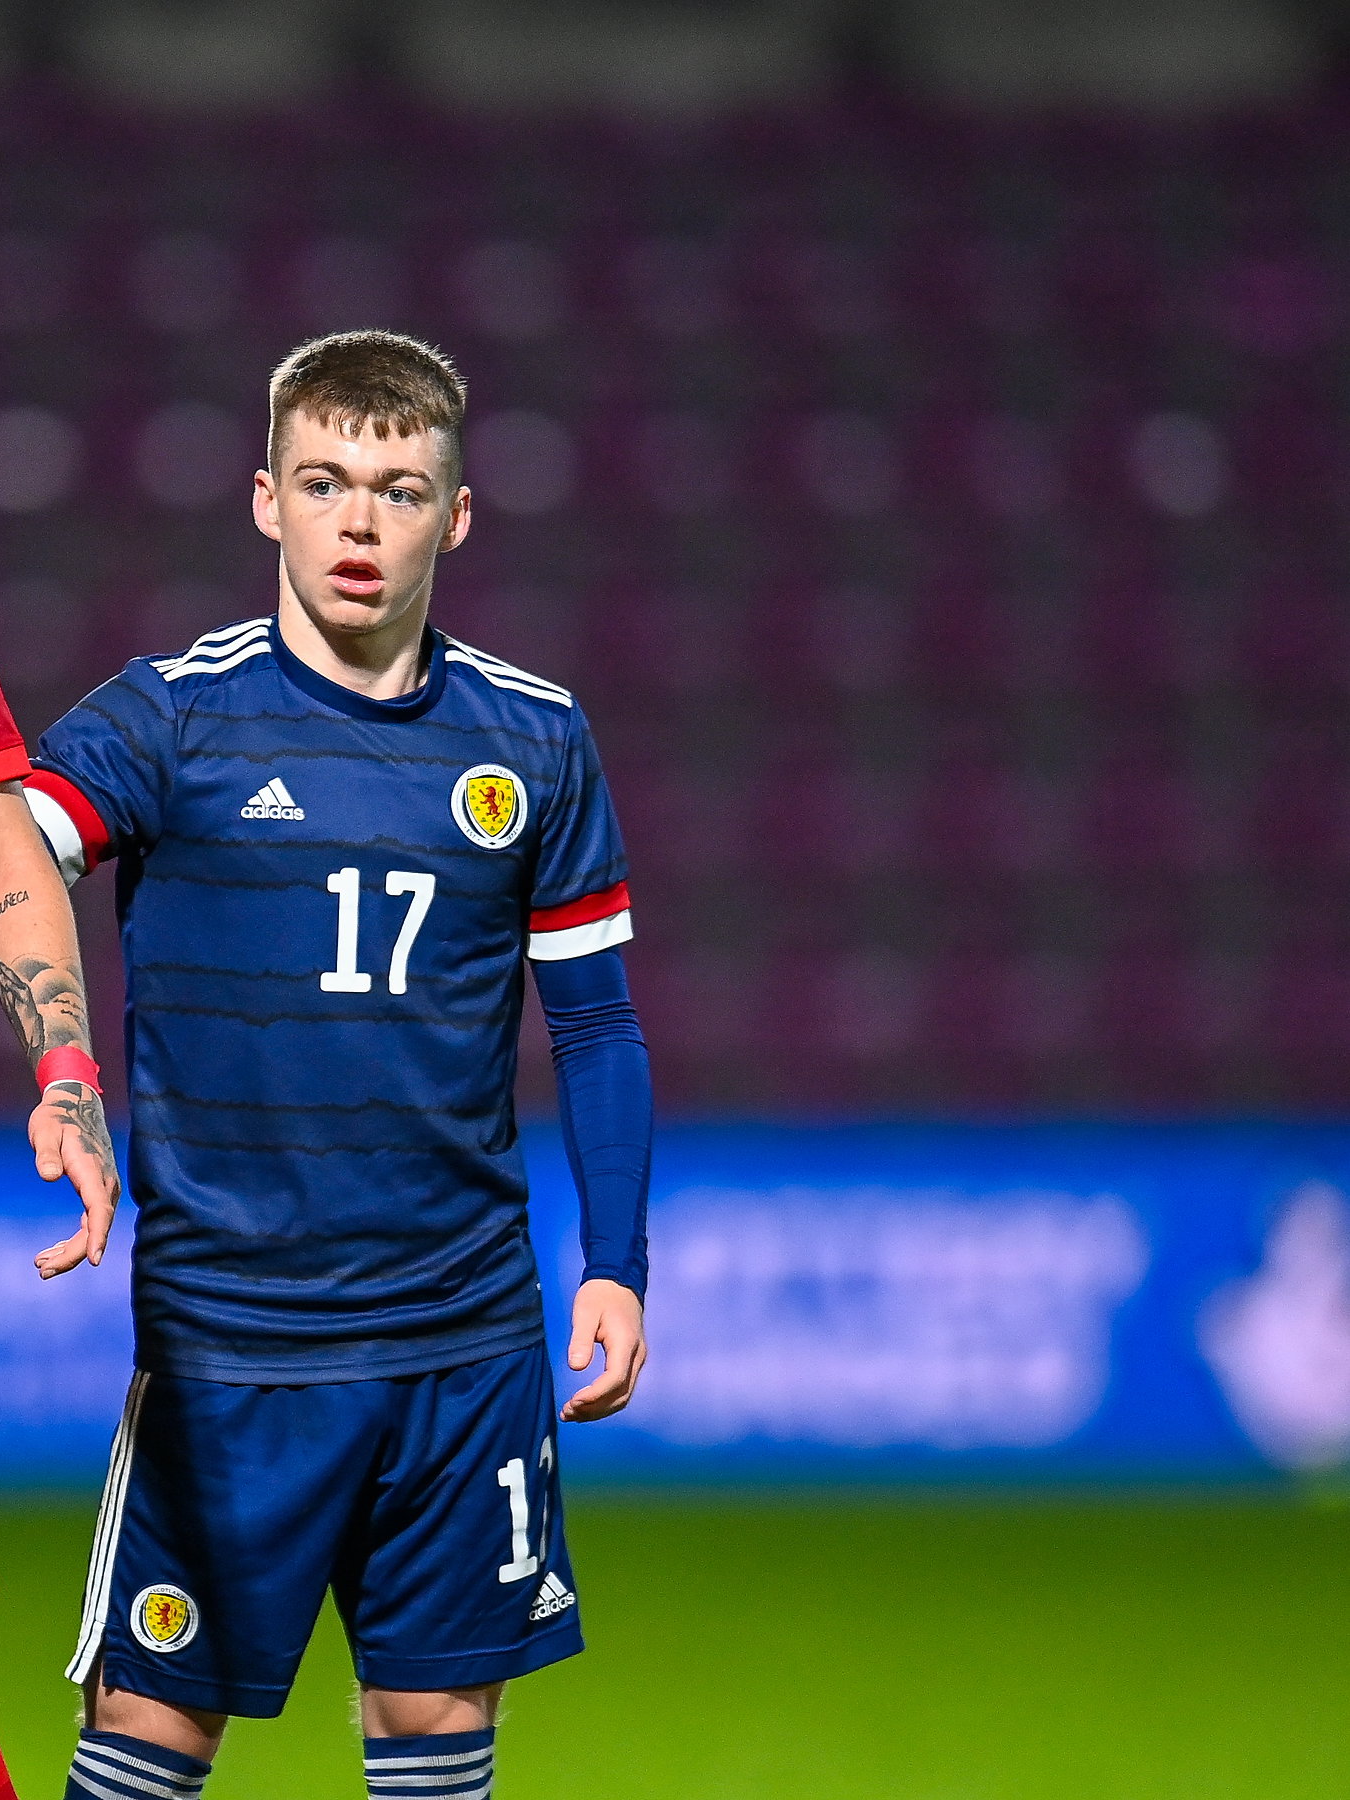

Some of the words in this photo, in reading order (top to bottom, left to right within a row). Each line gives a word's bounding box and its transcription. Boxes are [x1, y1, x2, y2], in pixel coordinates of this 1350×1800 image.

[470, 767, 508, 777] SCOTLAND
[240, 804, 306, 821] adidas
[319, 867, 436, 995] 17
[529, 1592, 576, 1621] adidas
